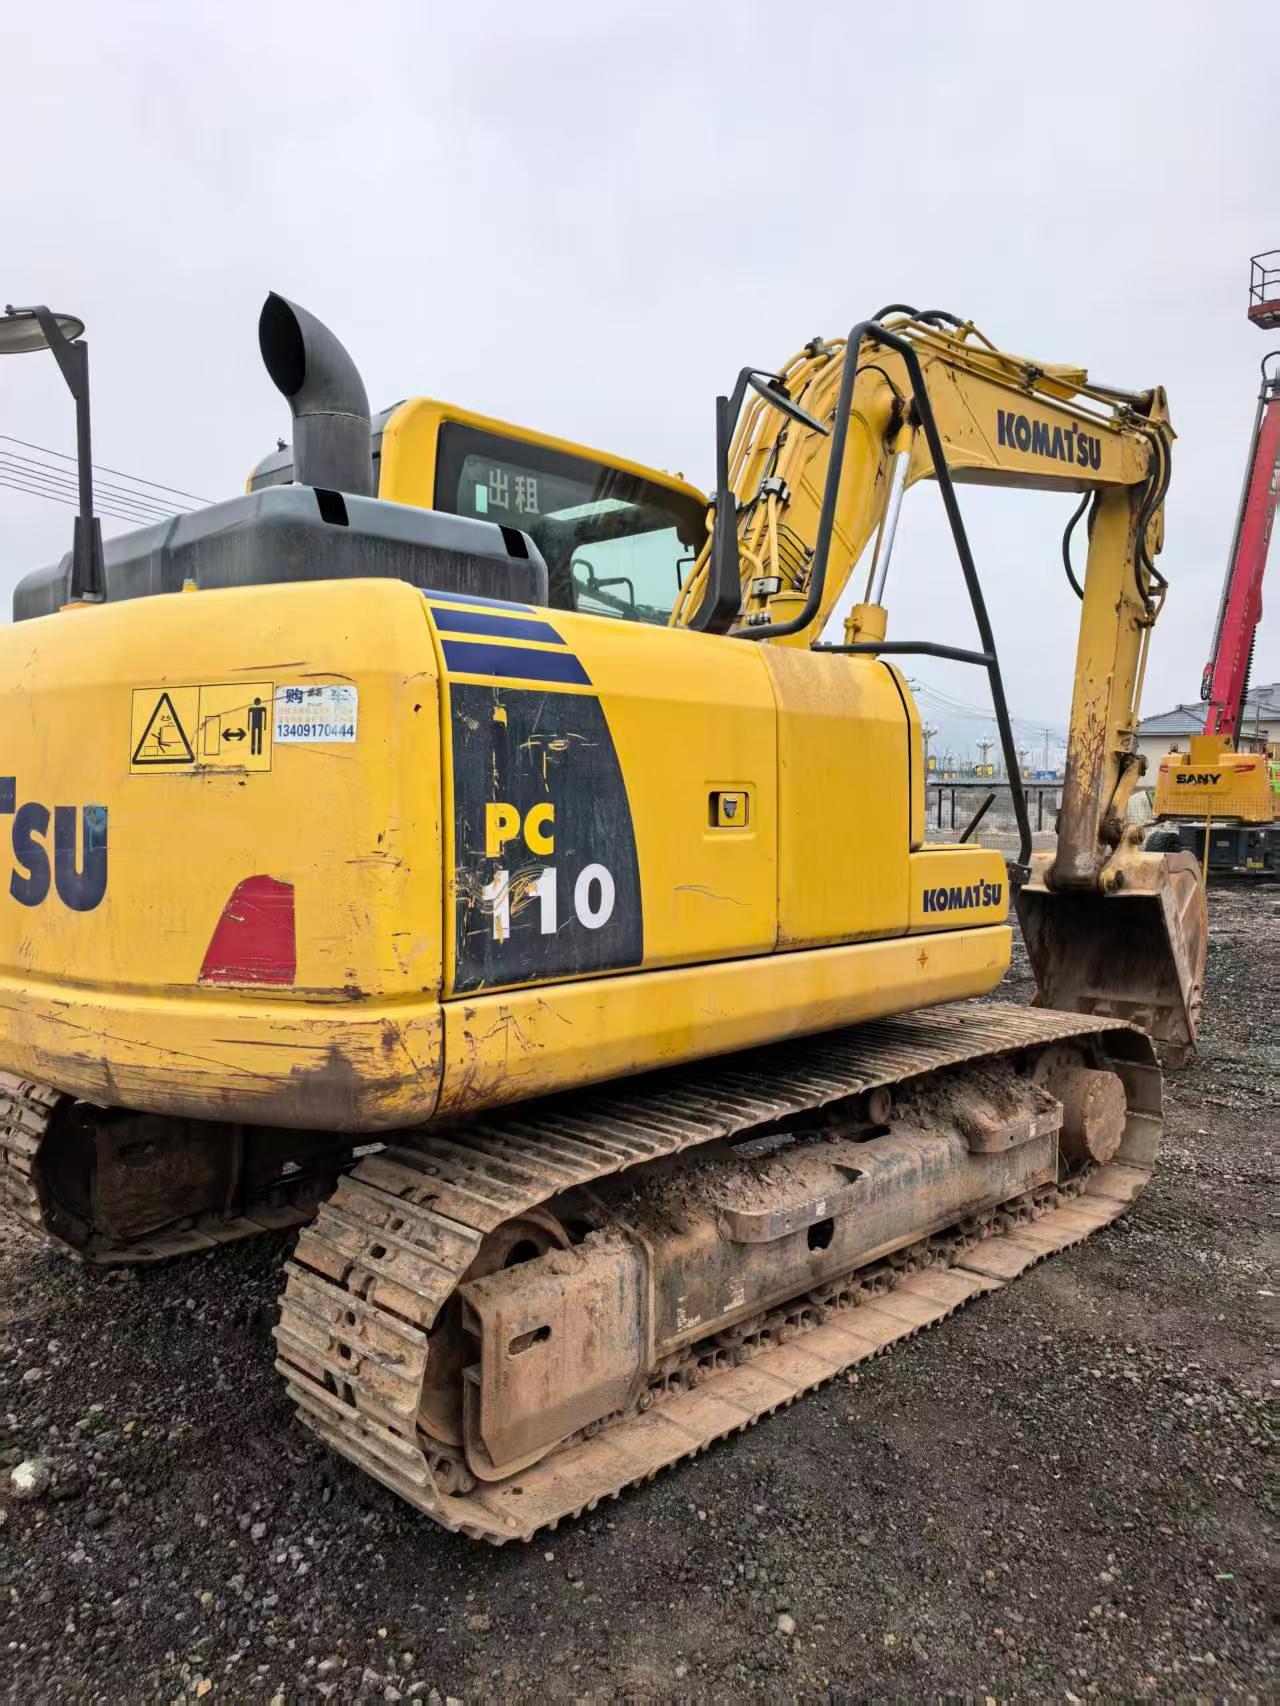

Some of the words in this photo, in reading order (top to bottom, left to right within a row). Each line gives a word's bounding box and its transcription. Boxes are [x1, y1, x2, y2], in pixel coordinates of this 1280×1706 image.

[997, 409, 1102, 470] KOMATSU
[489, 468, 540, 514] 出租
[277, 723, 354, 737] 13409170444
[1176, 773, 1222, 785] SANY
[485, 802, 555, 858] PC
[482, 862, 616, 942] 110
[922, 878, 1002, 913] KOMATSU
